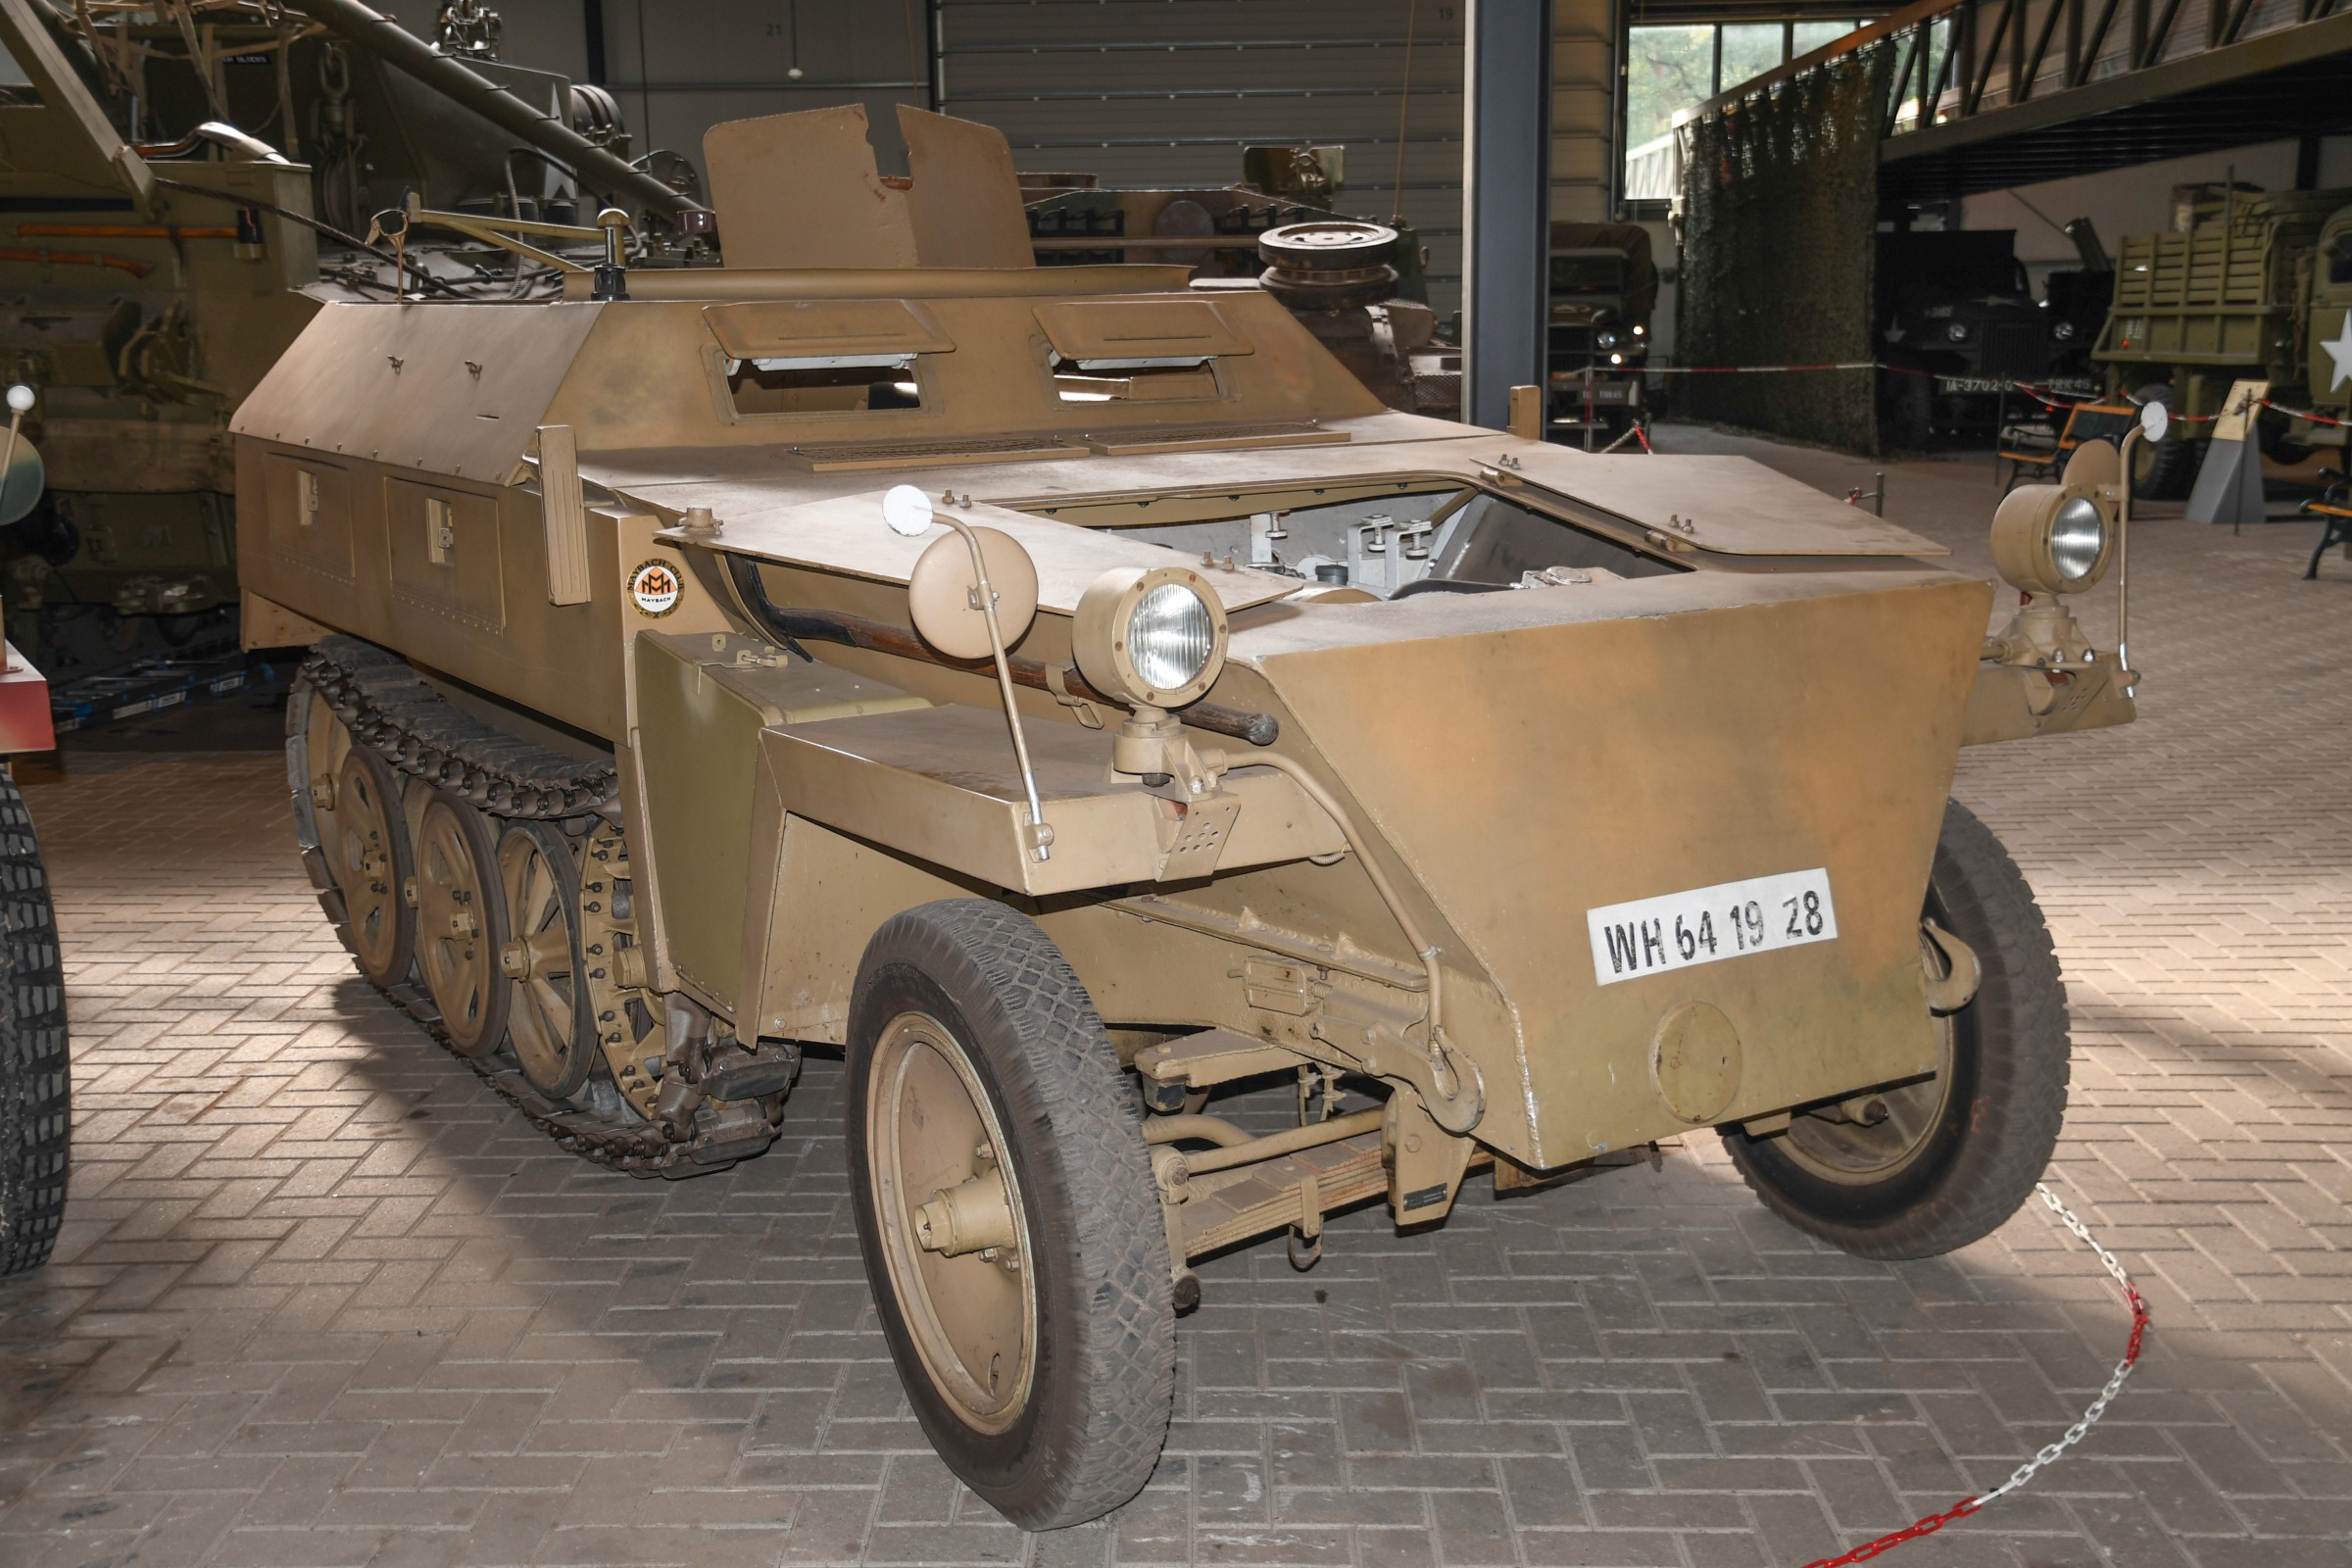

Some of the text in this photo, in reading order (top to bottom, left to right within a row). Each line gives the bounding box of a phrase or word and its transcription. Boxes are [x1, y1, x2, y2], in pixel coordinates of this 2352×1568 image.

[627, 559, 685, 590] MAYBACH CLUB
[1603, 890, 1824, 974] WH 64 19 28
